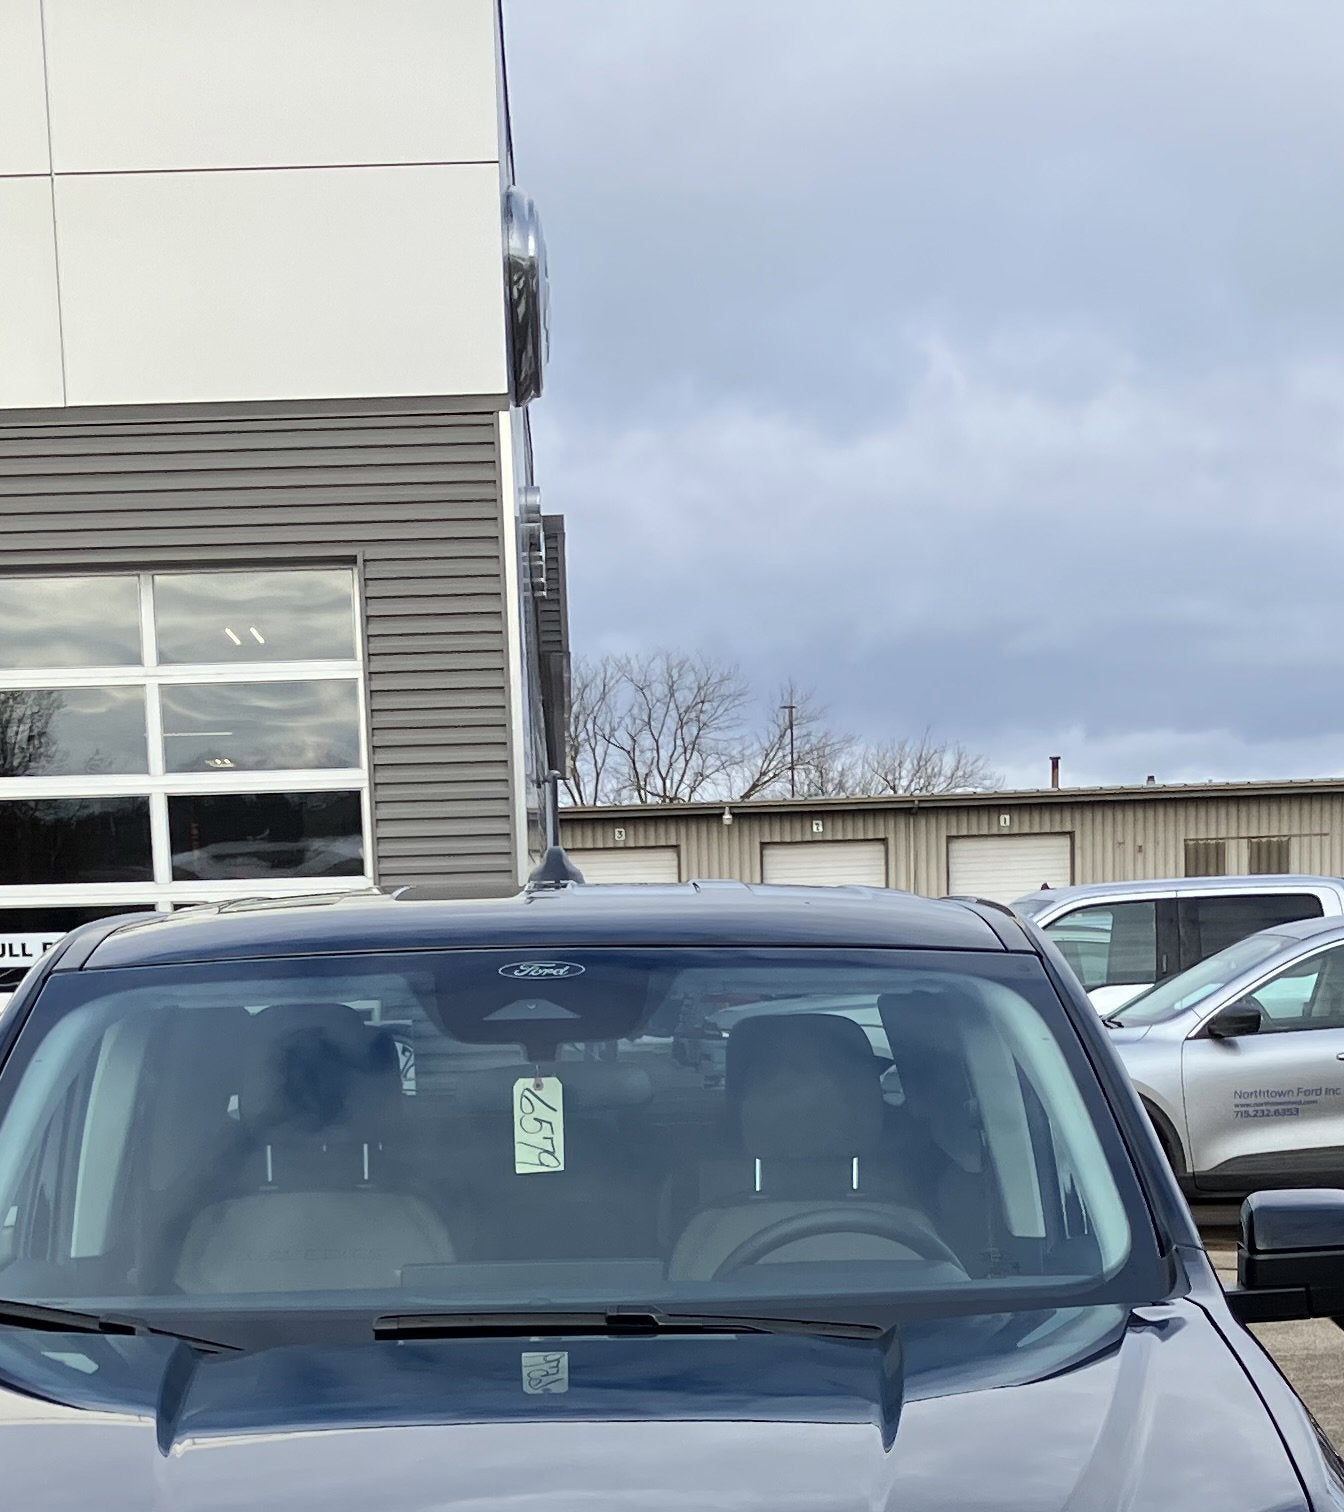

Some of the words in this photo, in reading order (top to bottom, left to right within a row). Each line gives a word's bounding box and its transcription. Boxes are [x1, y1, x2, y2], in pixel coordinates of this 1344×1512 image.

[514, 963, 570, 976] Ford
[1233, 1088, 1295, 1100] Northtown
[1296, 1086, 1322, 1097] Ford
[516, 1087, 561, 1169] 6579
